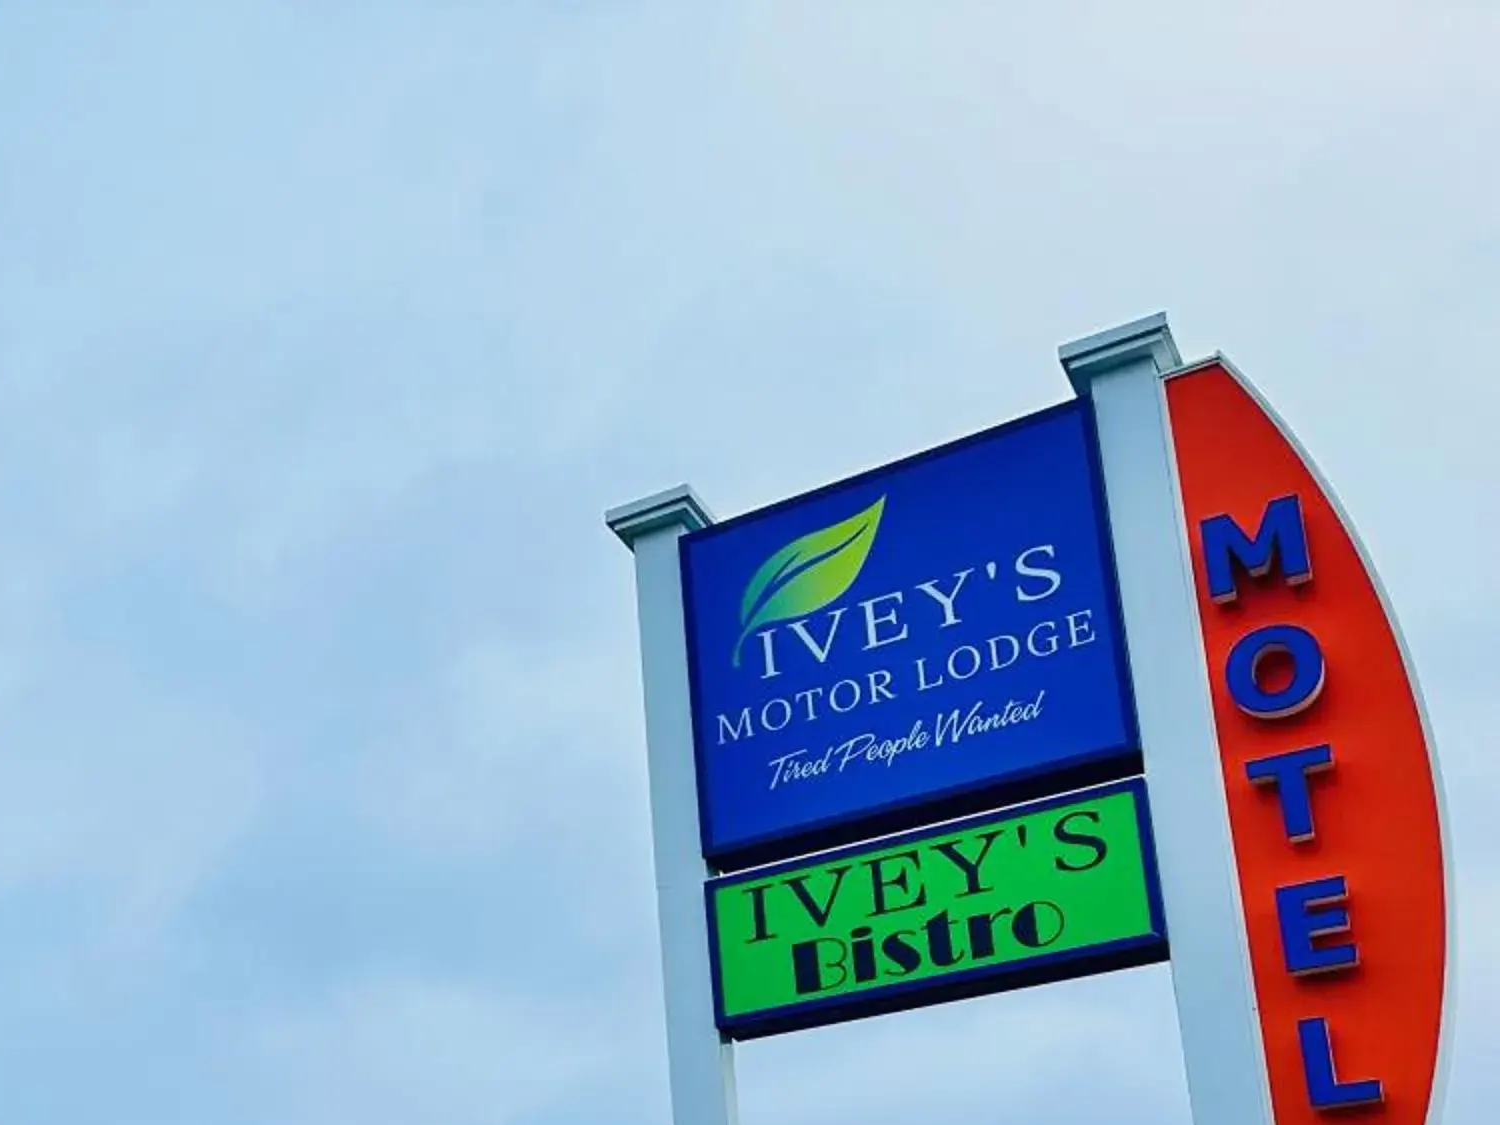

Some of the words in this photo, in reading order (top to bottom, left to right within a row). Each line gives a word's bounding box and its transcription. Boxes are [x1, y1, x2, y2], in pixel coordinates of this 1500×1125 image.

[716, 670, 898, 745] MOTOR
[916, 609, 1097, 691] LODGE
[756, 544, 1063, 679] IVEY'S
[767, 747, 833, 791] Tired
[835, 719, 931, 772] People
[934, 690, 1046, 747] Wanted
[1200, 494, 1385, 1111] MOTEL
[742, 811, 1108, 943] IVEY'S
[791, 900, 1065, 995] Bistro
